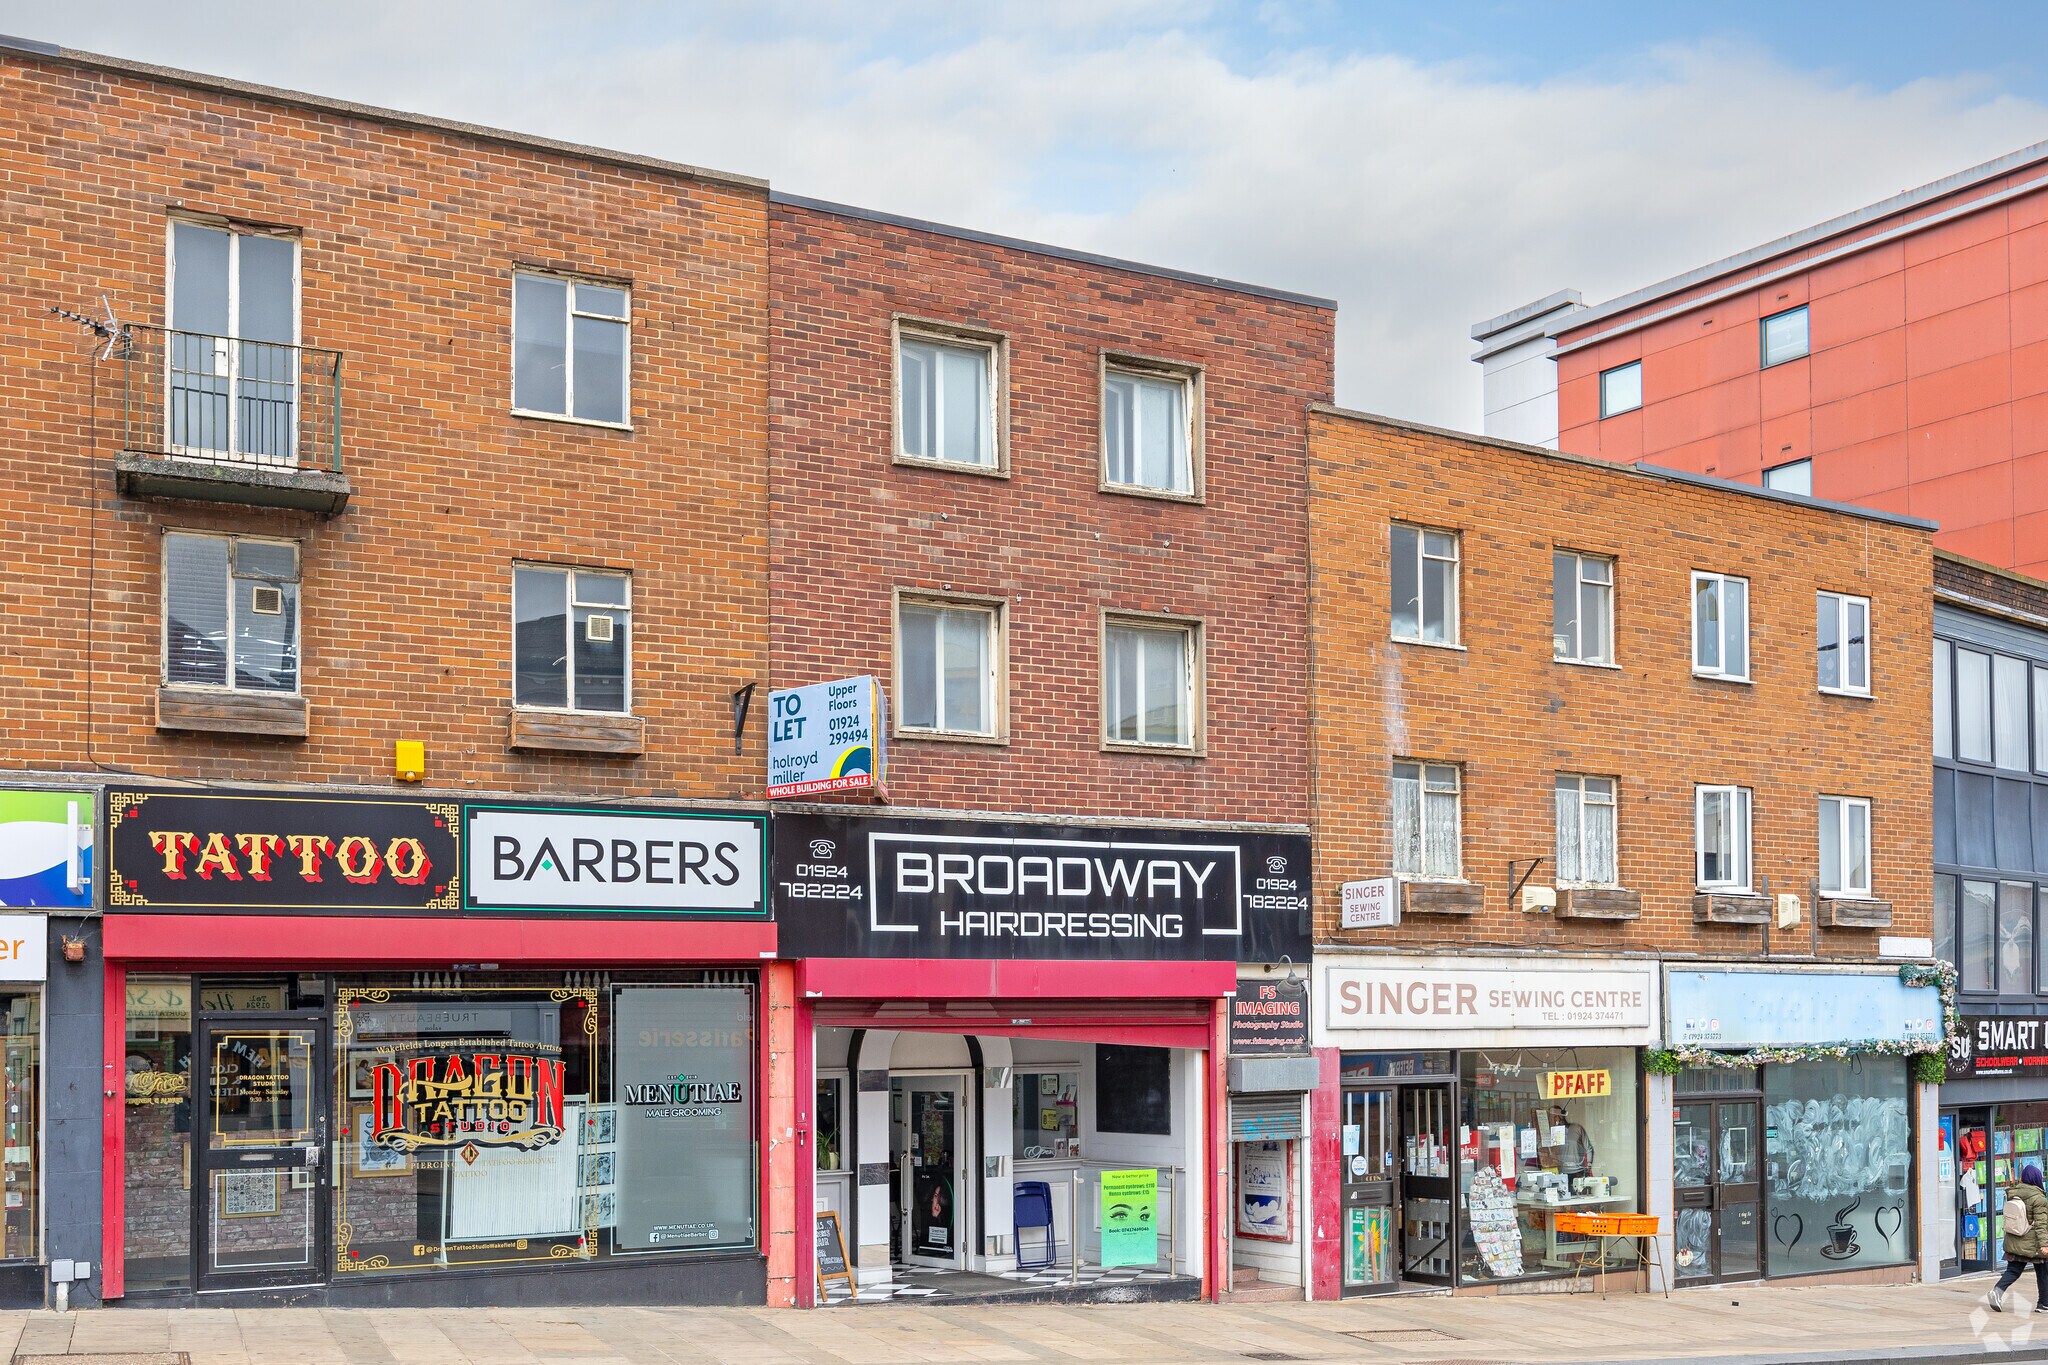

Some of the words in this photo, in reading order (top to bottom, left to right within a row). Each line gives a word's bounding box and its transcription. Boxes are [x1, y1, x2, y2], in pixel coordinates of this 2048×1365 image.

[828, 684, 858, 699] Upper
[773, 694, 802, 718] TO
[828, 698, 858, 712] Floors
[773, 716, 807, 743] LET
[829, 715, 860, 731] 01924
[829, 728, 869, 746] 299494
[772, 751, 819, 770] holroyd
[769, 786, 796, 797] WHOLE
[796, 781, 833, 793] BUILDING
[832, 780, 848, 790] FOR
[849, 776, 869, 787] SALE
[772, 770, 805, 785] miller
[147, 830, 434, 886] TATTOO
[493, 834, 741, 887] BARBERS
[796, 863, 849, 879] 01924
[896, 851, 1217, 899] BROADWAY
[779, 882, 864, 901] 782224
[1256, 877, 1298, 891] 01924
[1344, 885, 1386, 900] SINGER
[1243, 895, 1310, 911] 782224
[1349, 902, 1382, 913] SEWING
[939, 910, 1184, 938] HAIRDRESSING
[1349, 911, 1382, 923] CENTRE
[1259, 985, 1277, 1000] FS
[1339, 980, 1479, 1016] SINGER
[1488, 989, 1566, 1009] SEWING
[1571, 990, 1643, 1009] CENTRE
[1235, 1001, 1301, 1016] IMAGING
[1542, 1011, 1561, 1021] TEL
[1567, 1011, 1592, 1021] 01924
[1595, 1010, 1624, 1021] 374471
[1232, 1020, 1280, 1031] Photography
[1280, 1020, 1304, 1029] Studio
[1977, 1020, 2040, 1051] SMART
[375, 1041, 423, 1055] Wakefields
[423, 1038, 458, 1049] Longest
[458, 1037, 507, 1048] Established
[507, 1038, 535, 1050] Tattoo
[536, 1041, 563, 1053] Artists
[1951, 1034, 1971, 1059] SU
[1975, 1056, 2019, 1068] SCHOOLWEAR
[1553, 1072, 1606, 1096] PFAFF
[371, 1054, 567, 1144] DRAGON
[624, 1082, 742, 1106] MENUTIAE
[414, 1099, 528, 1125] TATTOO
[645, 1108, 671, 1118] MALE
[671, 1107, 722, 1117] GROOMING
[429, 1121, 511, 1135] STUDIO
